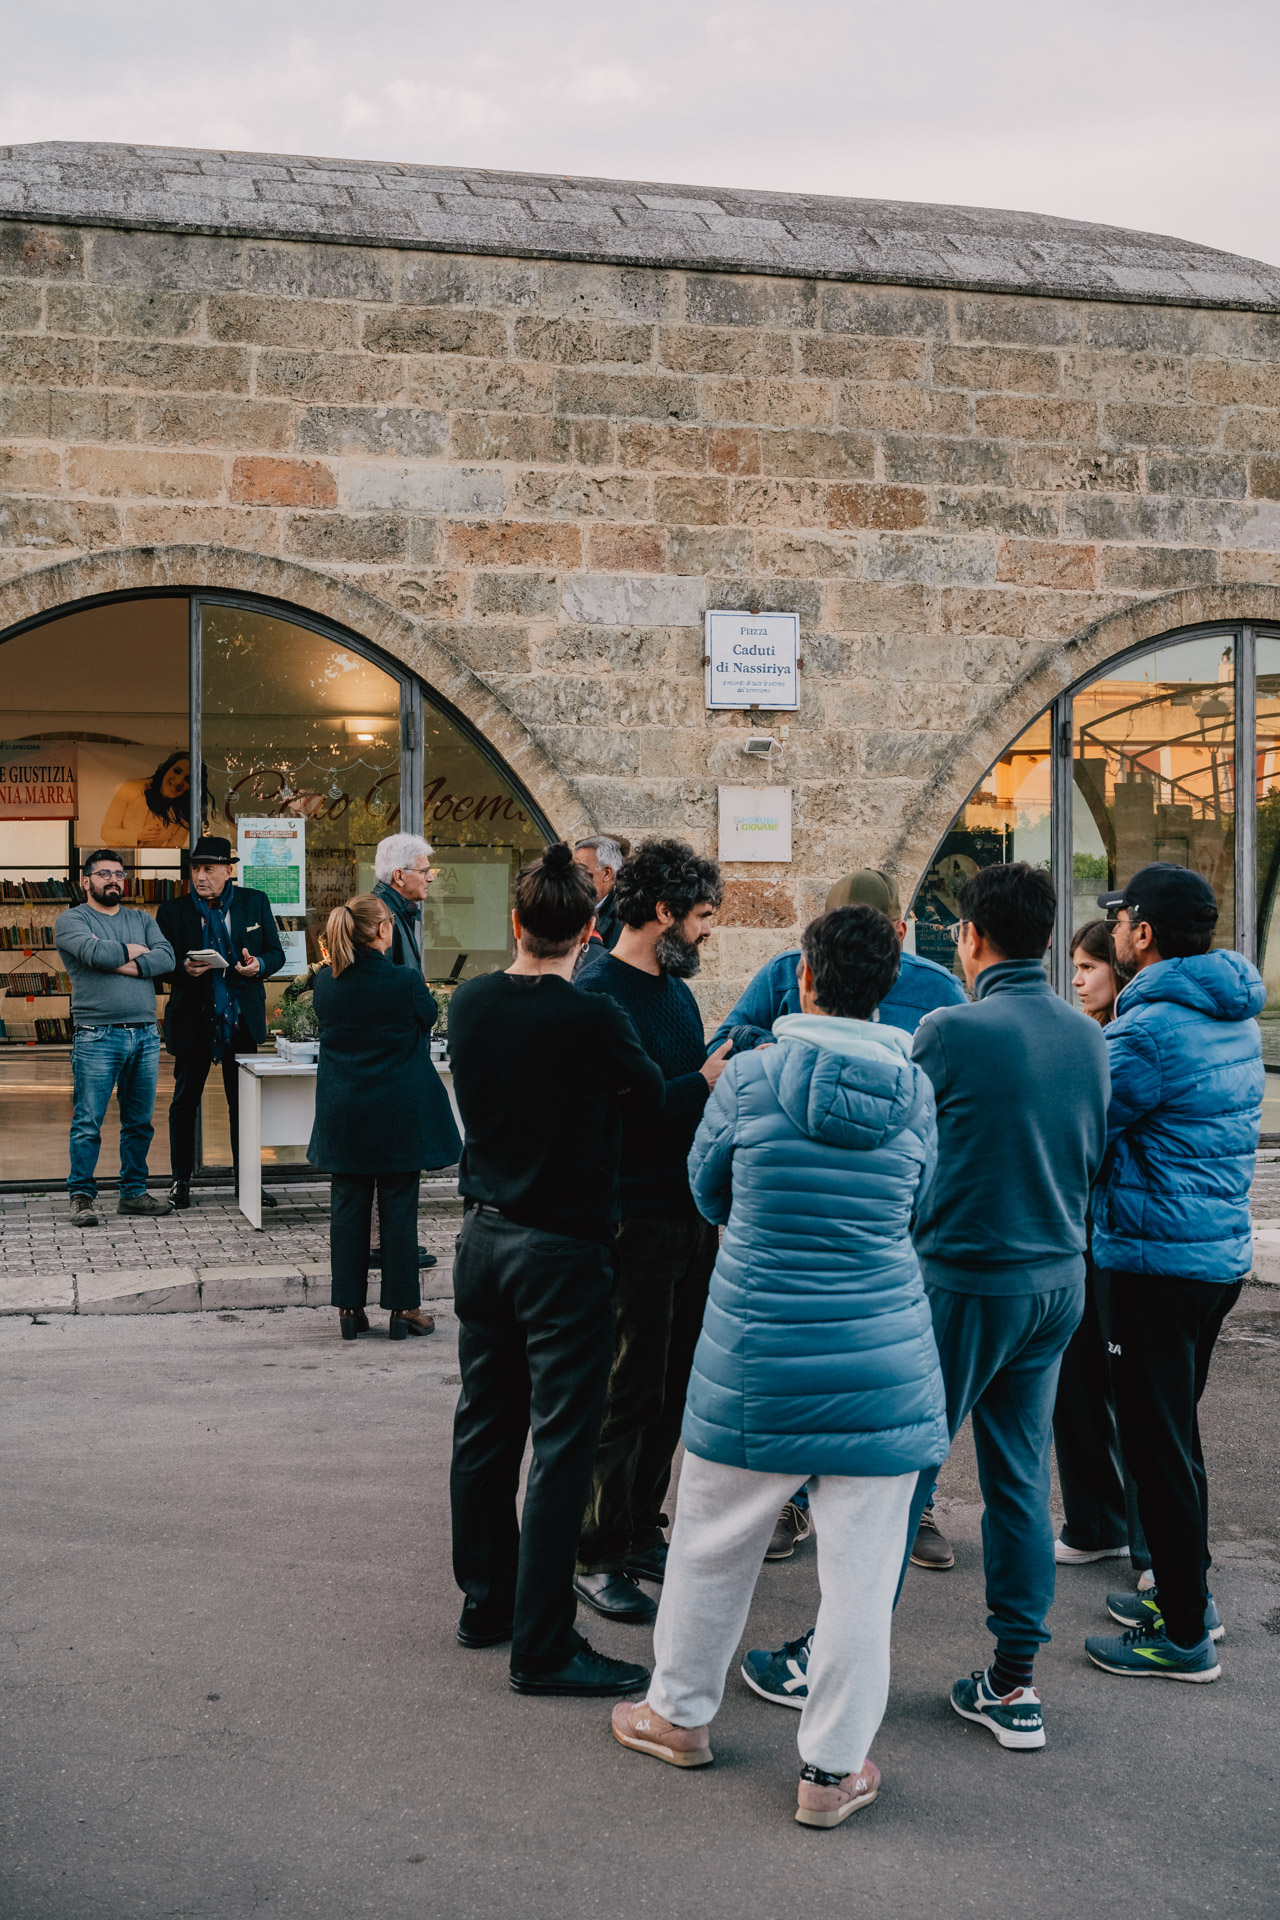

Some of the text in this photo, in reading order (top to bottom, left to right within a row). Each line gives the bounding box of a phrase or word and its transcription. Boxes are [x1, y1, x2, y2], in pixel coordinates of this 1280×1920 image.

[740, 627, 768, 636] Piazza
[732, 644, 776, 656] Caduti
[716, 662, 791, 676] di Nassiriya
[0, 766, 75, 783] E GIUSTIZIA
[25, 786, 75, 804] MARRA
